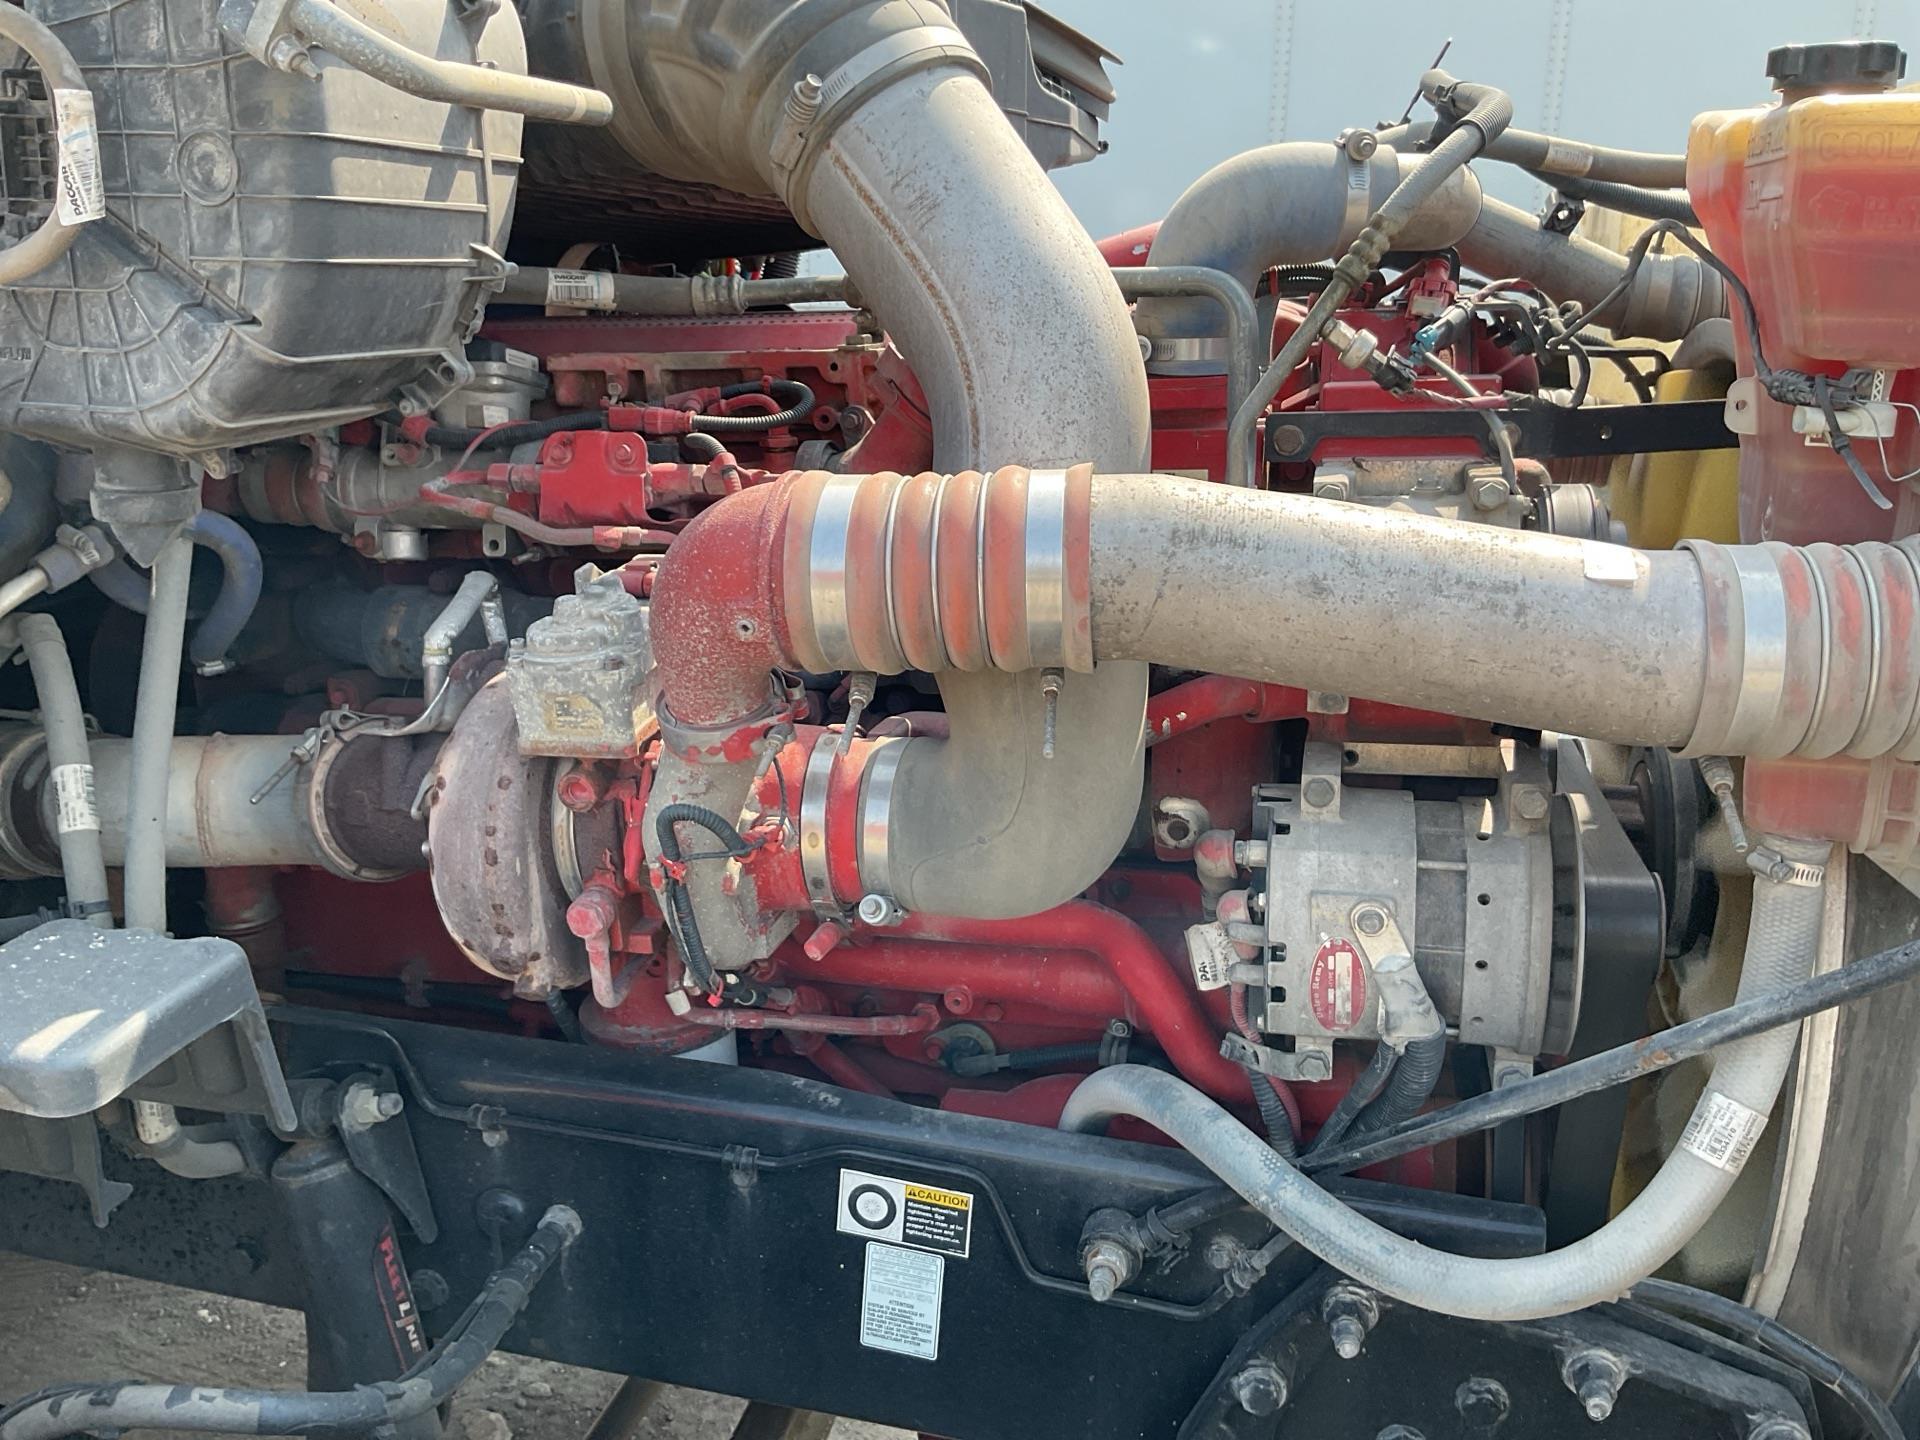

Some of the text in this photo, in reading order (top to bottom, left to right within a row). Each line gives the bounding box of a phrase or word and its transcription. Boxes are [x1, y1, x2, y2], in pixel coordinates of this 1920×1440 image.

[61, 165, 82, 217] PACCAR
[1312, 959, 1324, 989] Remy
[917, 1189, 968, 1208] CAUTION
